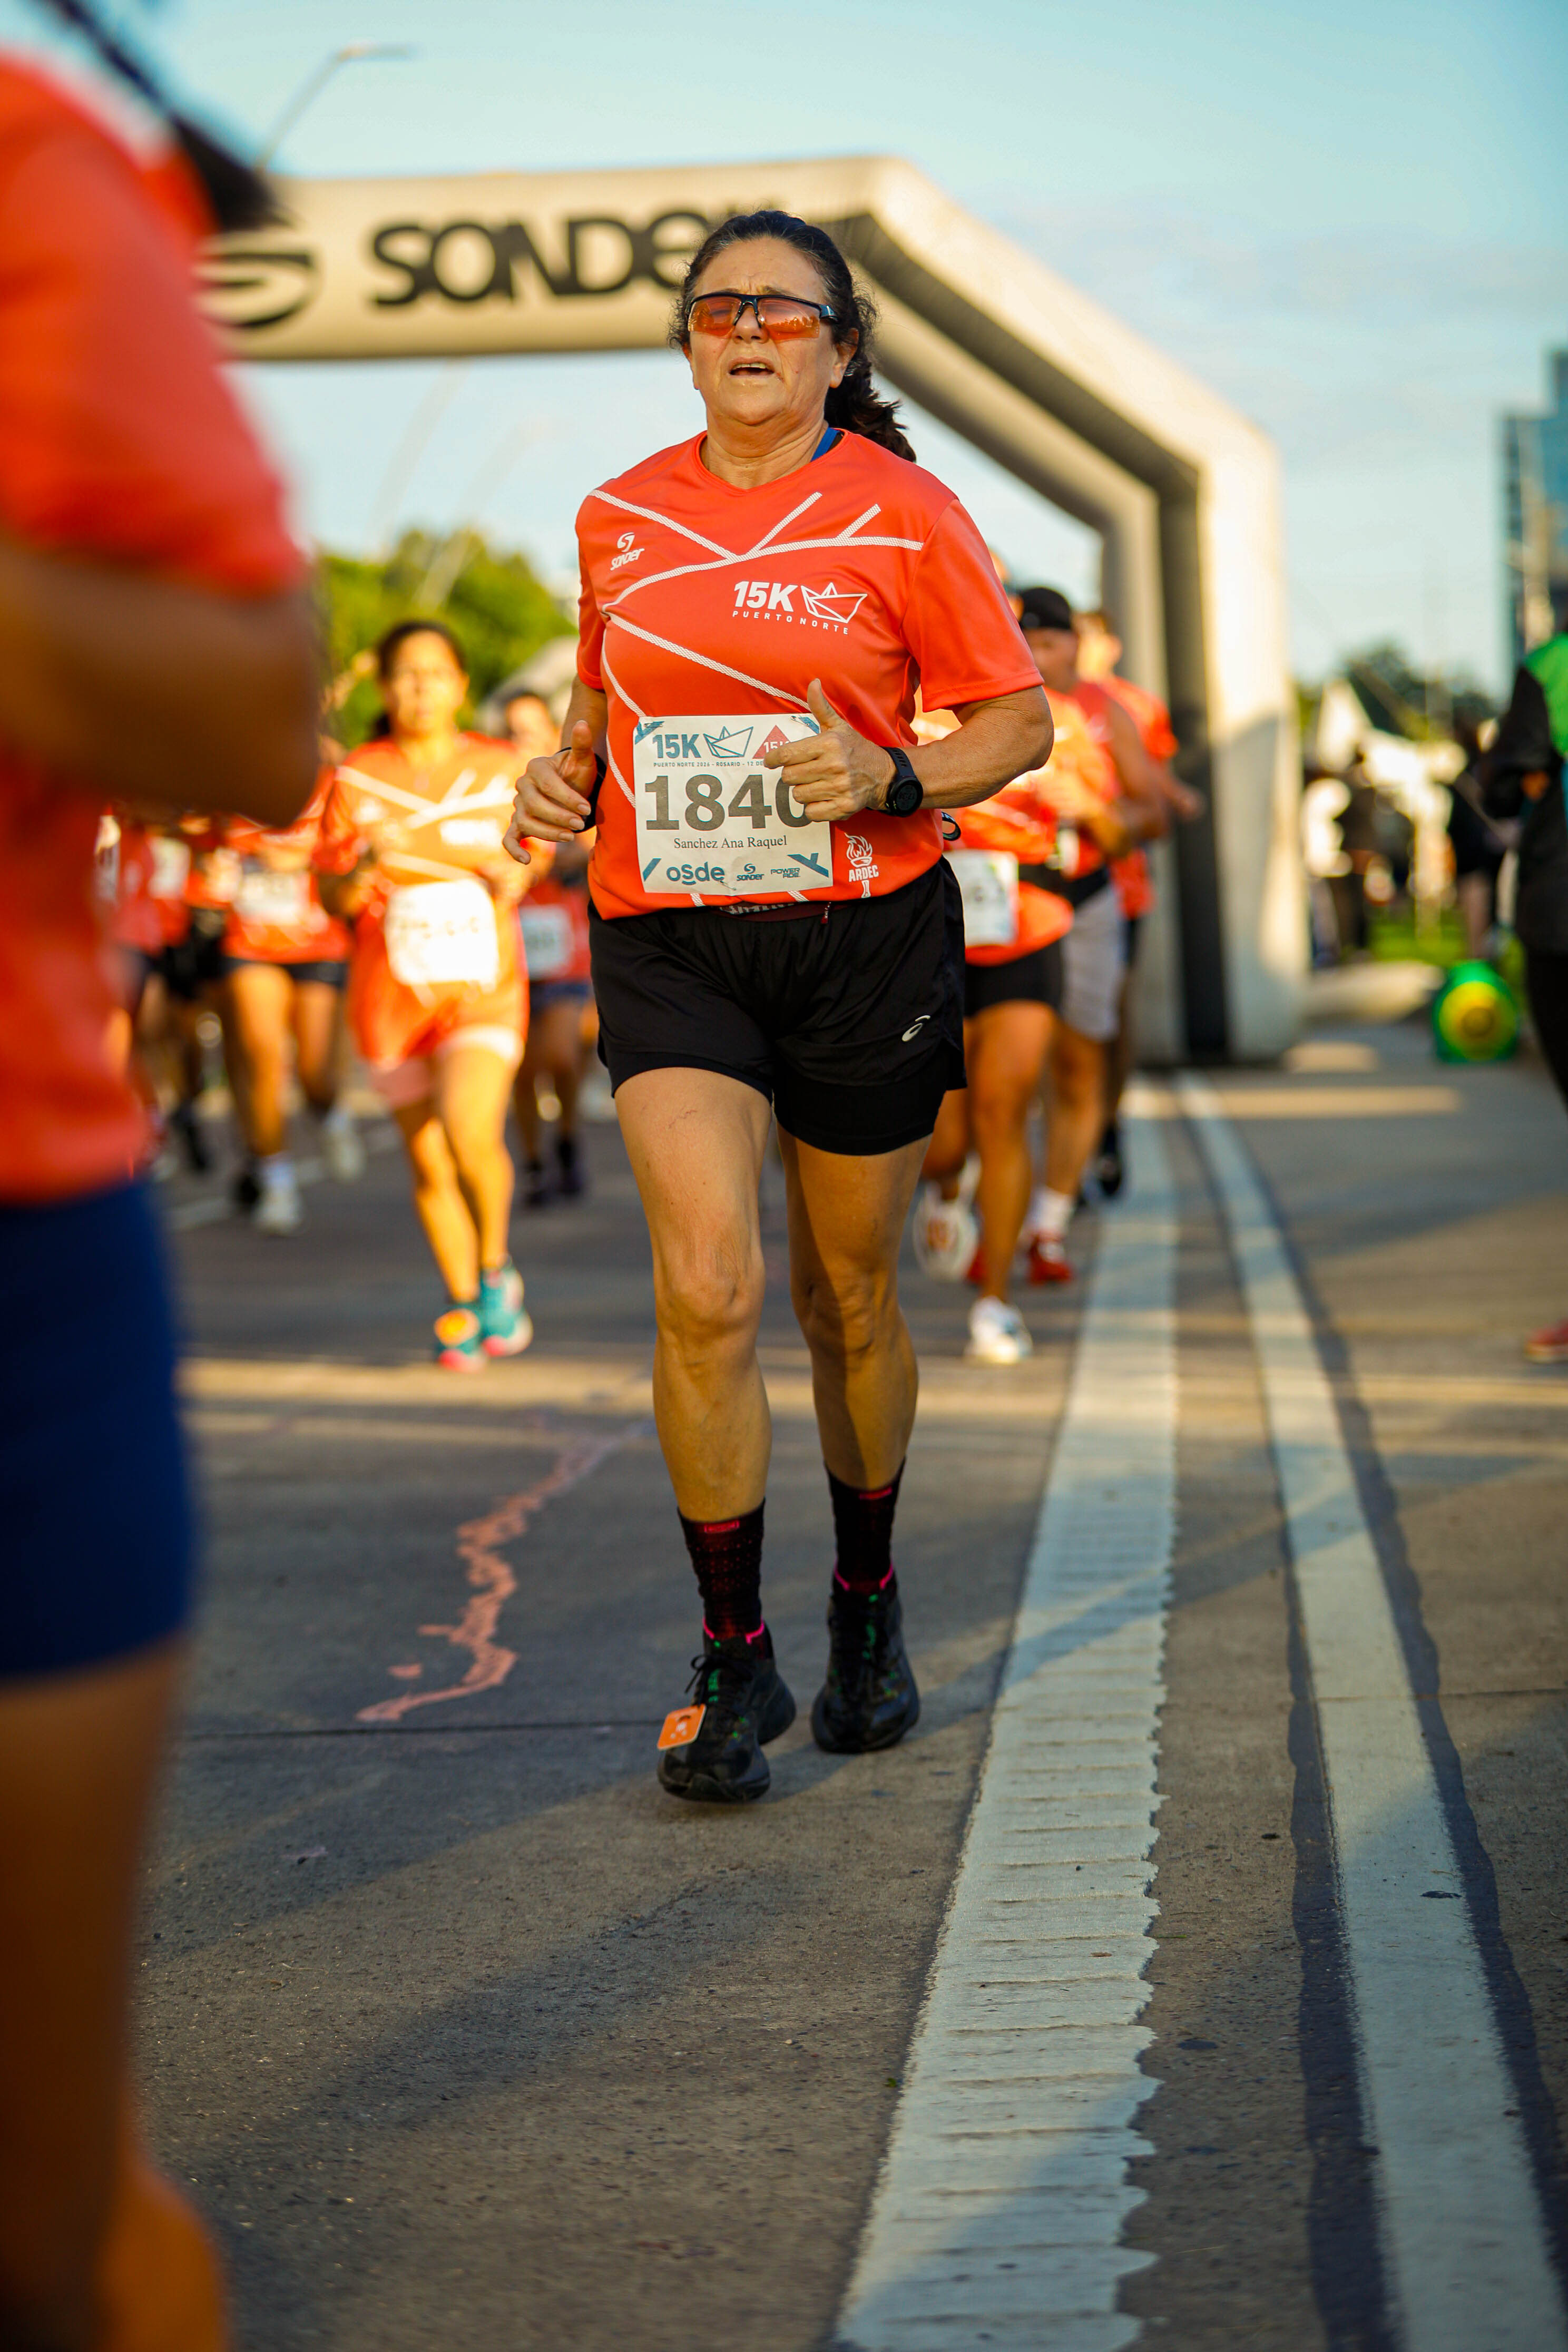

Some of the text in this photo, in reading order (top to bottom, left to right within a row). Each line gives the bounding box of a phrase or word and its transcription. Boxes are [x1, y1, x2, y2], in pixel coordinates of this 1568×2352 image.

[734, 581, 798, 612] 15K
[732, 610, 849, 635] PUERTO NORTE
[652, 734, 701, 759] 15K
[763, 741, 790, 753] 15
[645, 775, 814, 831] 1840
[674, 835, 788, 849] Sanchez Ana Raquel
[666, 861, 725, 882] osde
[849, 865, 879, 883] ARDEC
